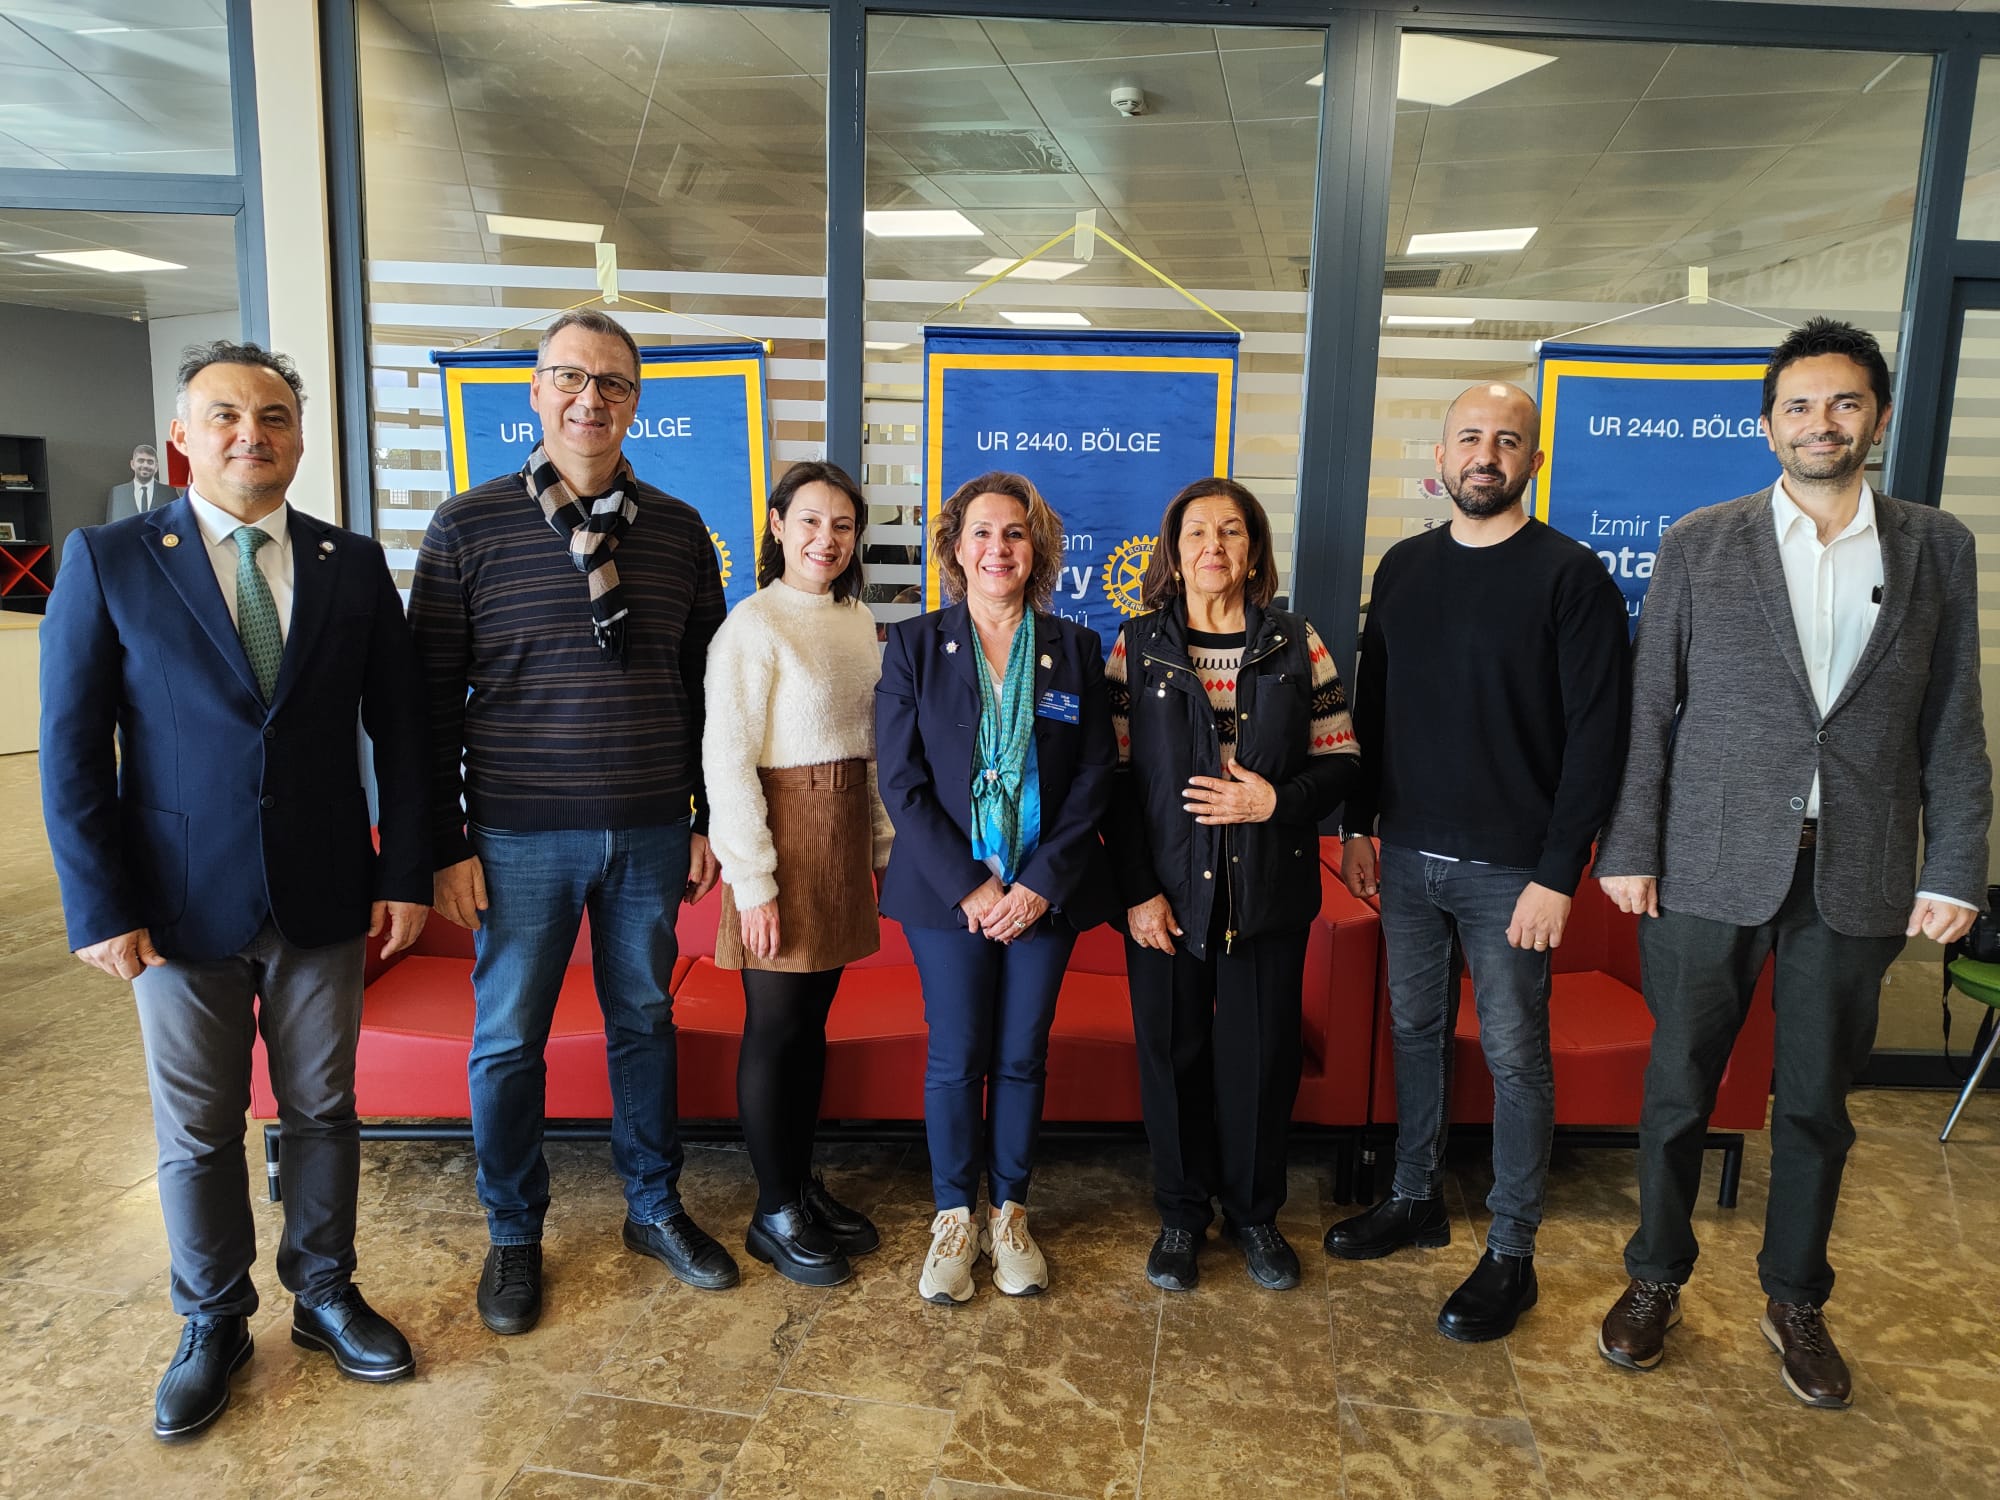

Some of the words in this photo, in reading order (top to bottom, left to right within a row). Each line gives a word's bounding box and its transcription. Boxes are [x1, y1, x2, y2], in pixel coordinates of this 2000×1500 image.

[500, 422, 535, 443] UR
[626, 413, 693, 439] ÖLGE
[1589, 415, 1622, 437] UR
[1627, 417, 1684, 438] 2440.
[977, 431, 1009, 451] UR
[1015, 432, 1073, 451] 2440.
[1081, 427, 1161, 452] BÖLGE
[1589, 509, 1651, 537] İzmir
[1658, 515, 1671, 537] E
[1060, 534, 1093, 551] am
[1127, 545, 1155, 555] ROTA
[1577, 540, 1657, 579] ota
[1055, 566, 1093, 600] ry
[1114, 590, 1145, 611] INTERN
